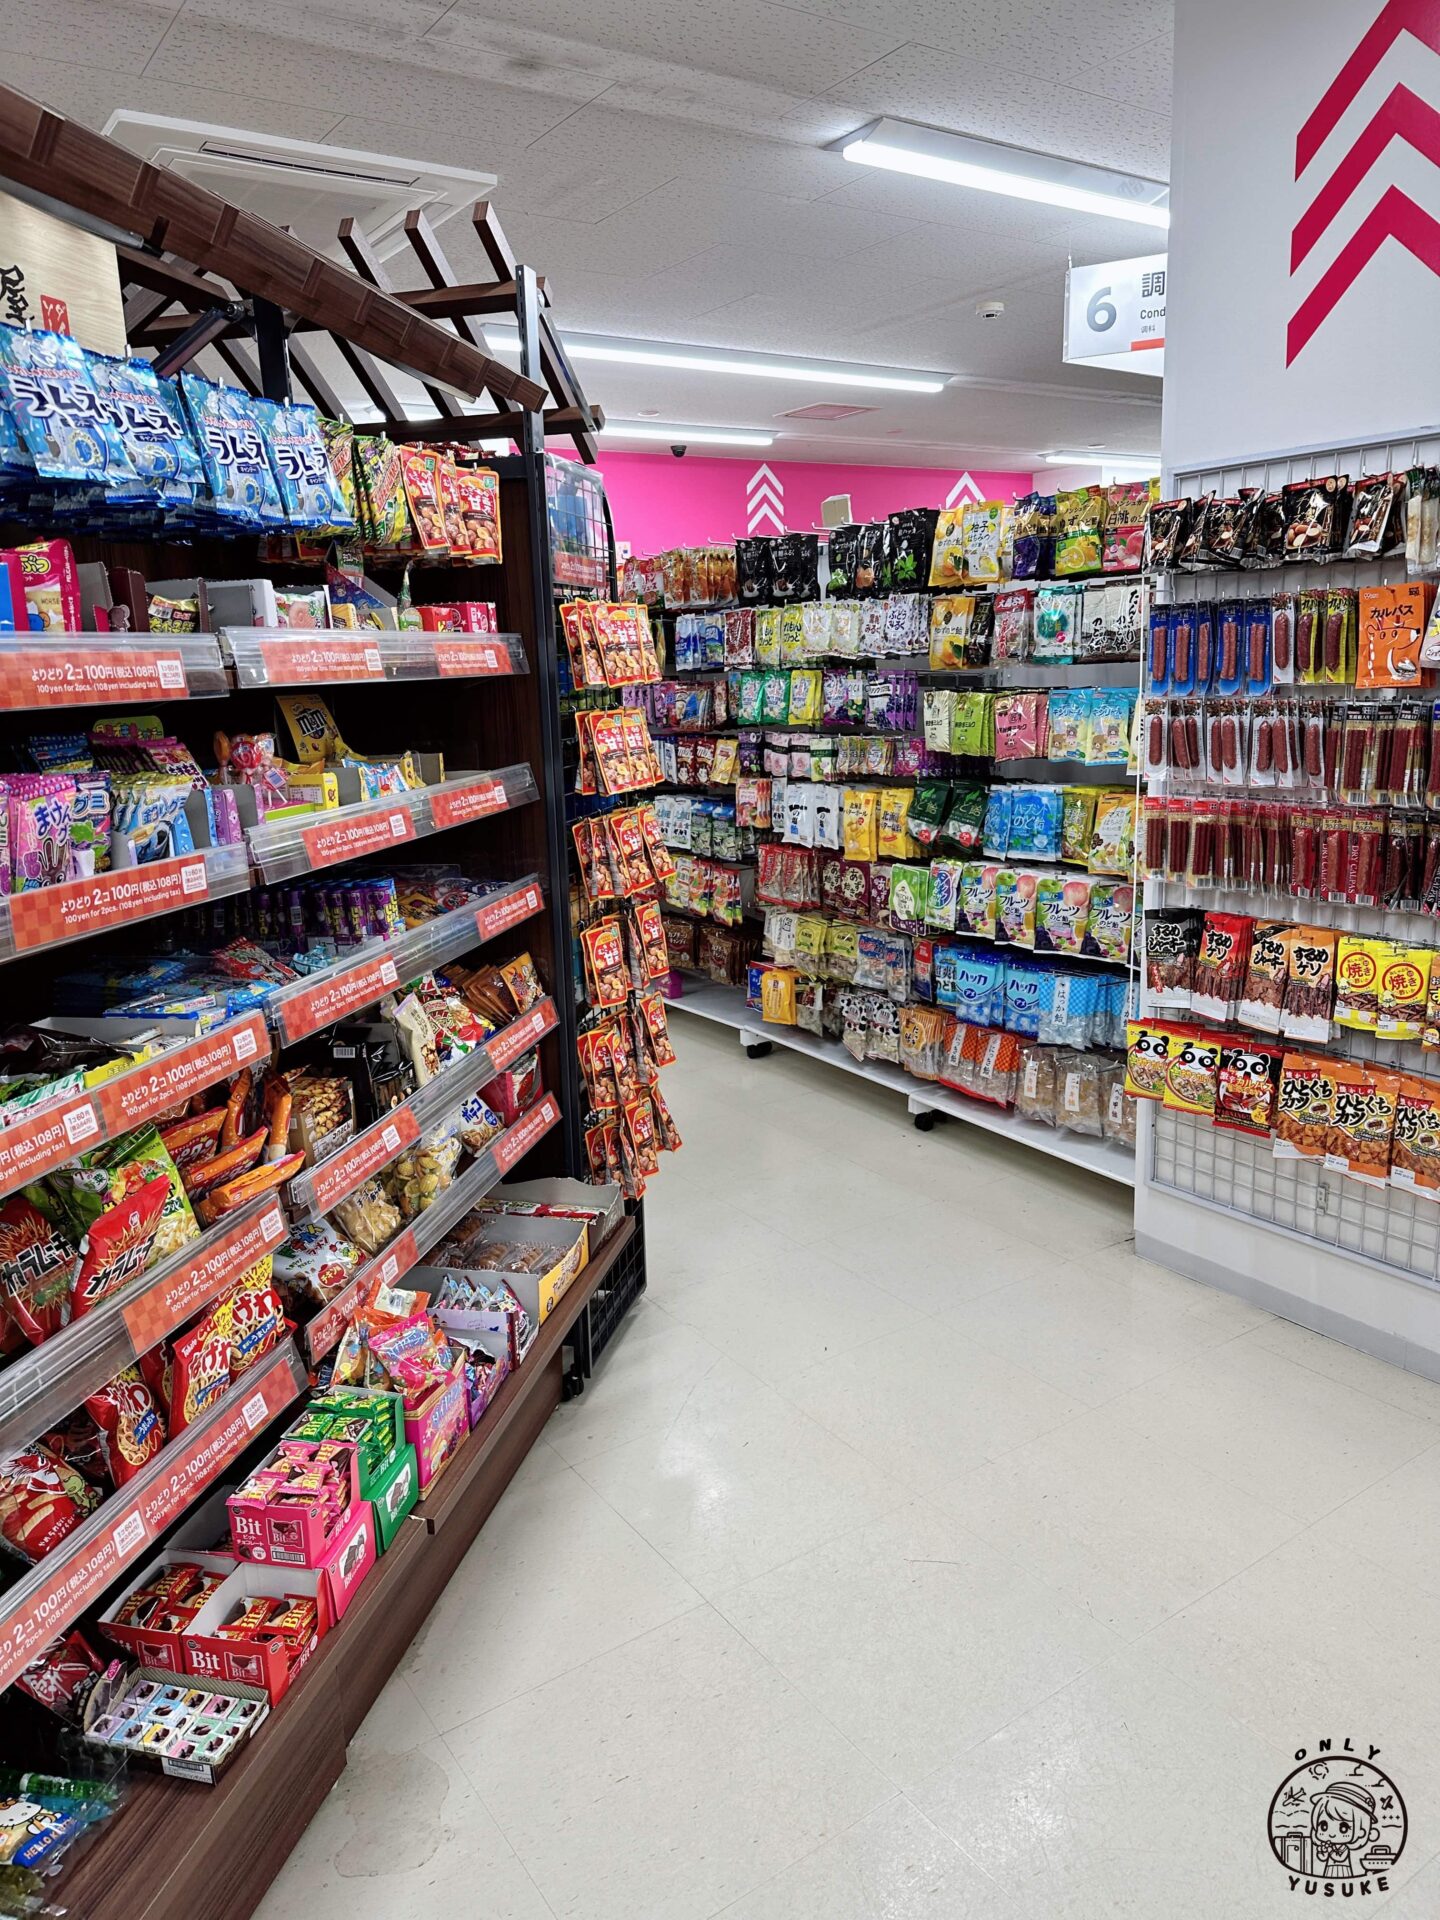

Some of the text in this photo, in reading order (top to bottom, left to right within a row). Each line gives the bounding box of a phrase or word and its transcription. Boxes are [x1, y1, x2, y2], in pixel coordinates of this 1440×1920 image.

[1141, 271, 1165, 298] 調
[1087, 286, 1117, 333] 6
[1140, 307, 1166, 319] Cond
[9, 374, 110, 425] ラムネ
[1370, 604, 1414, 619] カルパス
[31, 668, 64, 682] よりどり
[65, 663, 83, 680] 2コ
[37, 681, 158, 695] 100yen for 2pcs. (108yen including tax)
[1013, 815, 1046, 831] のど飴
[1348, 845, 1359, 894] DRY CALPAS
[60, 873, 182, 914] よりどり 2コ 100円(税込108円)
[1000, 896, 1029, 910] フルーツ
[65, 888, 182, 924] 100yen for 2pcs. (108yen including tax)
[1042, 903, 1081, 917] フルーツ
[1091, 908, 1133, 922] フルーツ
[1050, 914, 1069, 923] のど飴
[1152, 923, 1182, 938] するめ
[1206, 930, 1234, 950] するめ
[1261, 938, 1285, 955] するめ
[1292, 945, 1330, 964] するめ
[959, 969, 988, 986] ハッカ
[1009, 979, 1038, 995] ハッカ
[121, 1043, 232, 1108] よりどり 2コ 100円(税込108円)
[126, 1058, 232, 1117] 100yen for 2pcs. (108yen including tax)
[1281, 1079, 1333, 1099] ひとくち
[1278, 1096, 1311, 1111] カツ
[1335, 1094, 1393, 1115] ひとくち
[1332, 1110, 1367, 1127] カツ
[1394, 1126, 1419, 1141] カツ
[18, 1139, 66, 1170] including tax)
[165, 1281, 191, 1306] よりどり
[190, 1270, 207, 1287] 2コ
[205, 1226, 262, 1275] 100円(税込108円)
[170, 1239, 264, 1313] 100yen for 2pcs. (108yen including tax)
[145, 1415, 245, 1518] よりどり 2コ 100円(税込108円)
[150, 1428, 247, 1526] 100yen for 2pcs. (108yen including tax)
[234, 1516, 263, 1536] Bit
[273, 1532, 287, 1543] Bit
[13, 1541, 115, 1644] 2コ 100円(税込108円)
[13, 1646, 25, 1660] for
[25, 1628, 45, 1649] 2pcs.
[45, 1598, 73, 1629] (108yen
[73, 1569, 104, 1600] including
[103, 1557, 116, 1574] tax)
[282, 1607, 303, 1629] Bit
[190, 1650, 220, 1671] Bit
[231, 1665, 246, 1678] Bit
[24, 1836, 52, 1860] HELLO
